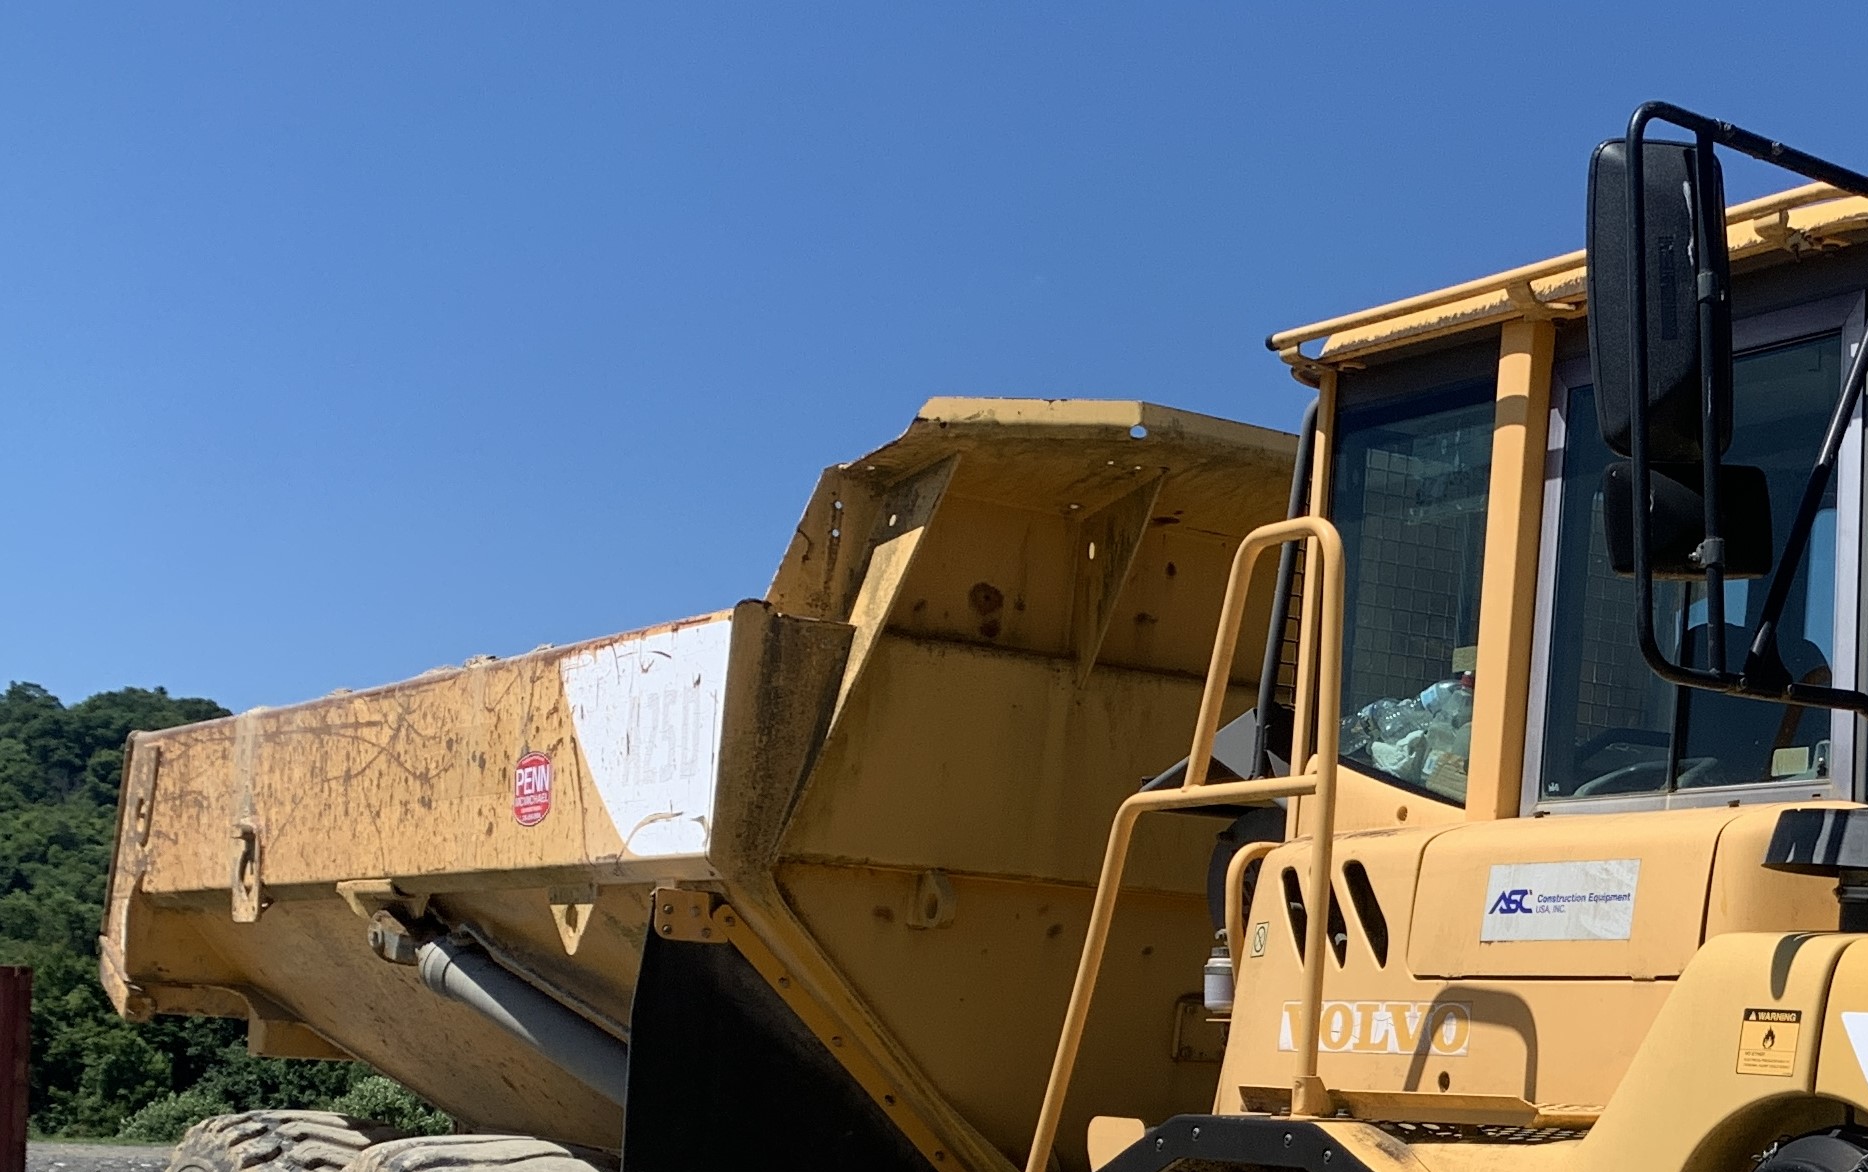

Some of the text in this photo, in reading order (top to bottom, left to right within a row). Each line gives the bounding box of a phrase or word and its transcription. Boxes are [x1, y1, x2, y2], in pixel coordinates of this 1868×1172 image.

[515, 764, 550, 796] PENN
[1537, 893, 1586, 903] Construction
[1588, 892, 1631, 904] Equipment
[1757, 1011, 1797, 1022] WARNING
